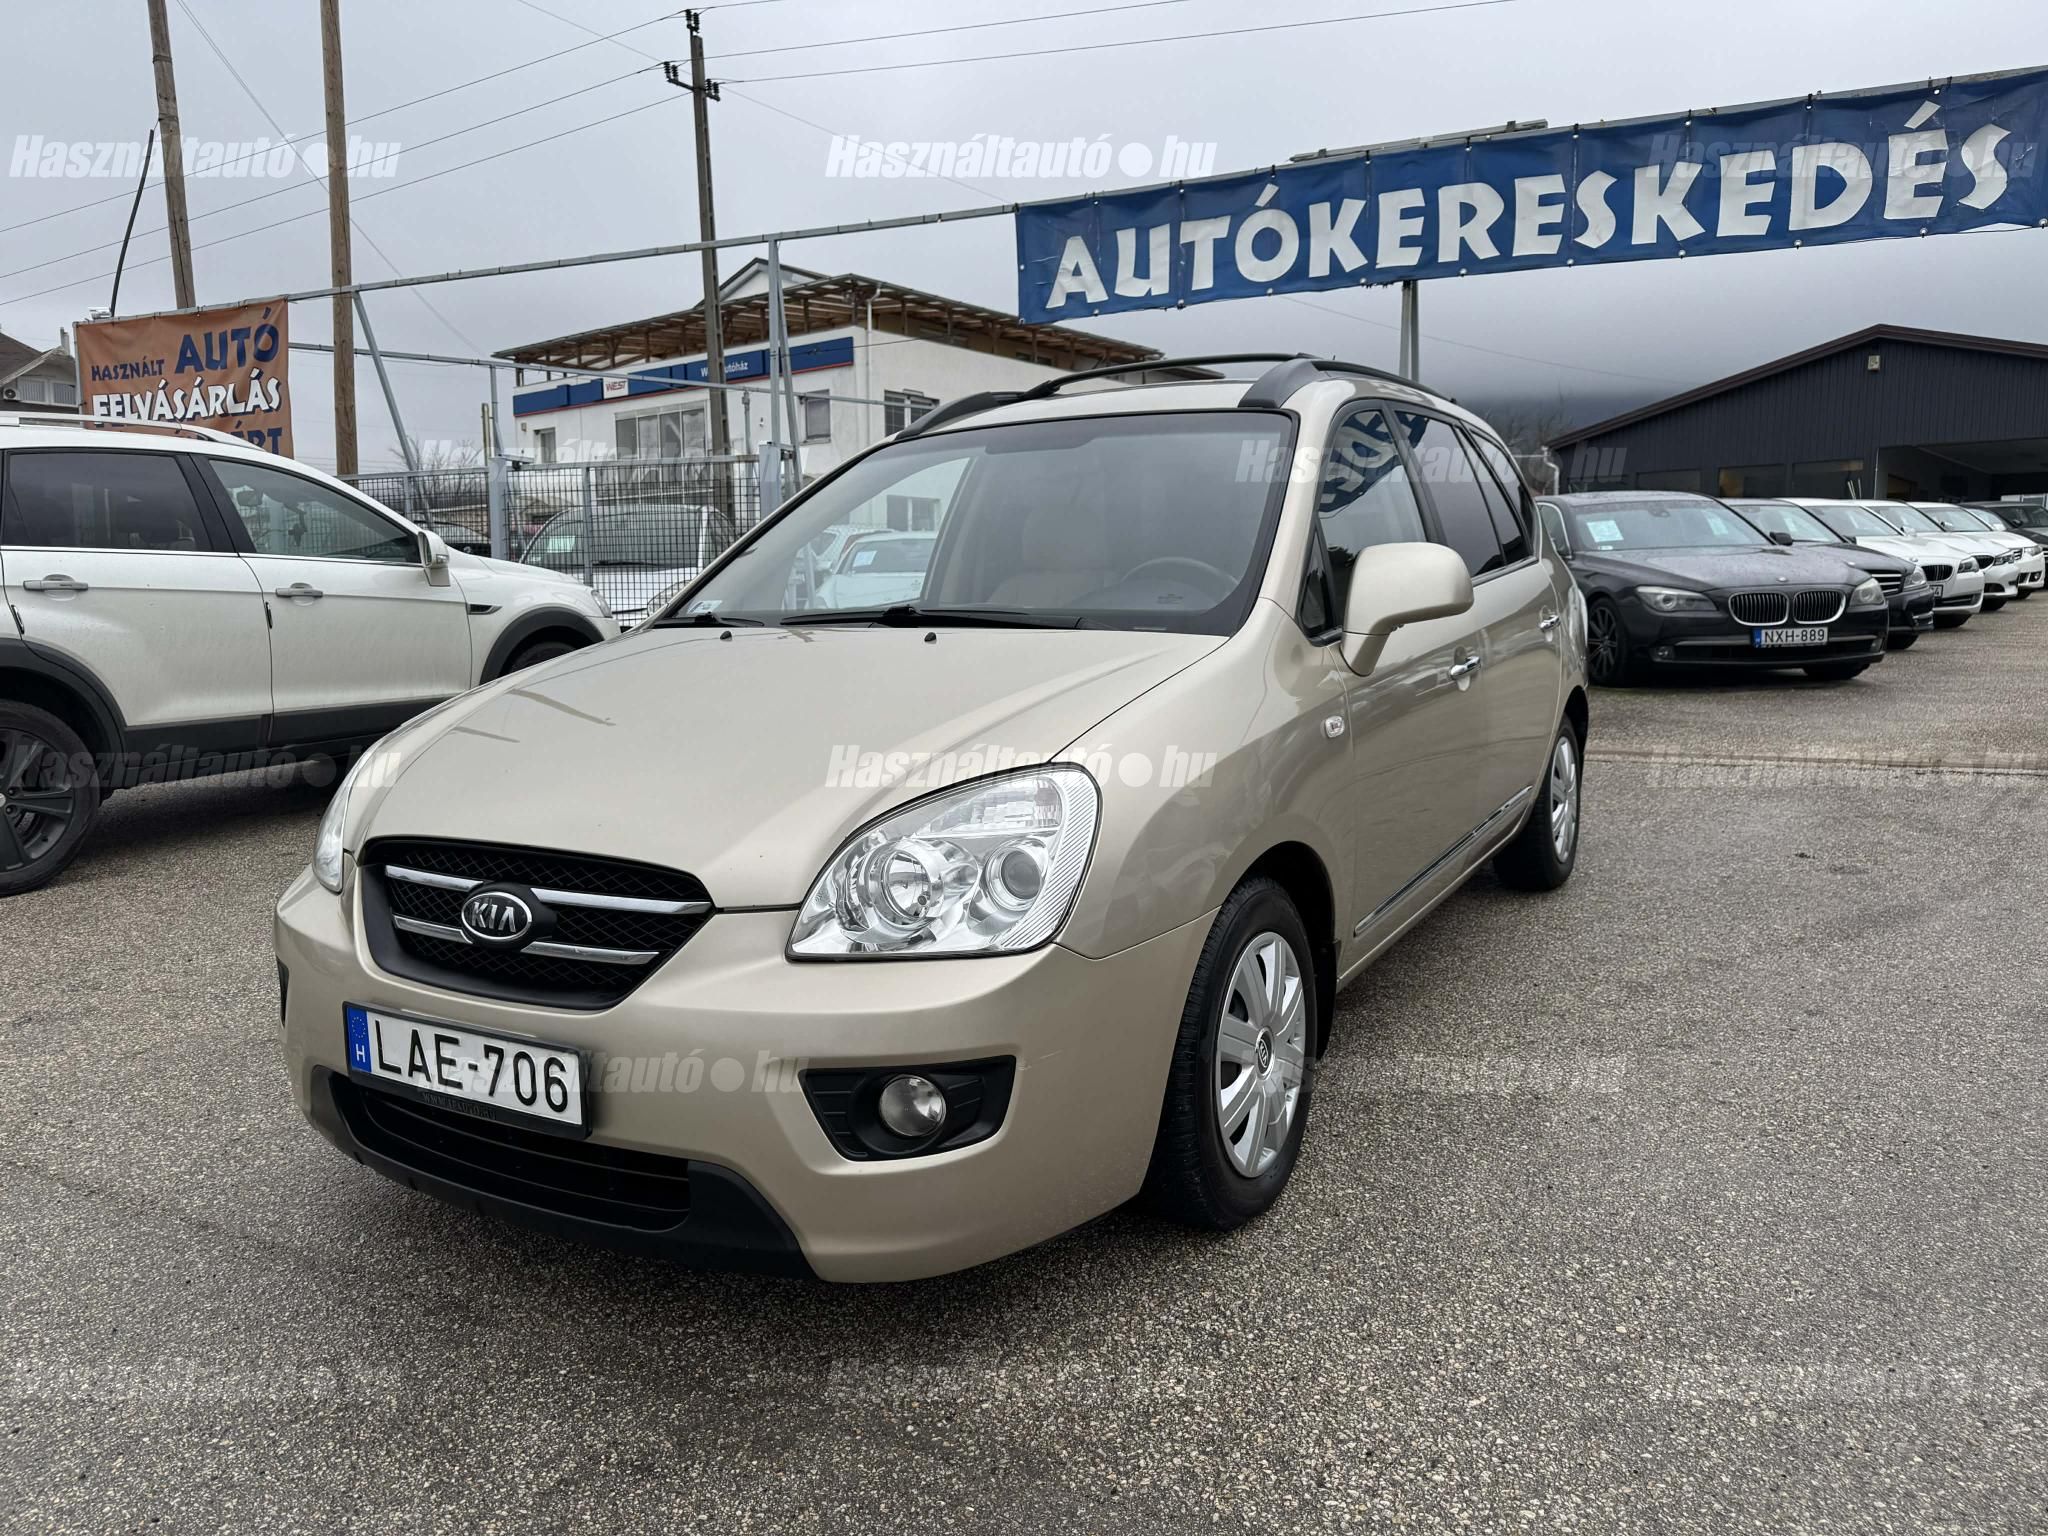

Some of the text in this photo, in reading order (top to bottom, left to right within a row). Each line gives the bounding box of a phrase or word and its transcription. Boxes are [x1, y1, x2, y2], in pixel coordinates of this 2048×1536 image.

[1045, 100, 2012, 308] AUTÓKERESKEDÉS
[91, 306, 280, 381] HASZNÁLT AUTÓ
[92, 367, 281, 427] FELVÁSÁRLÁS
[1764, 628, 1825, 643] NXH-889
[471, 901, 517, 933] KIA
[375, 1019, 569, 1113] LAE-706
